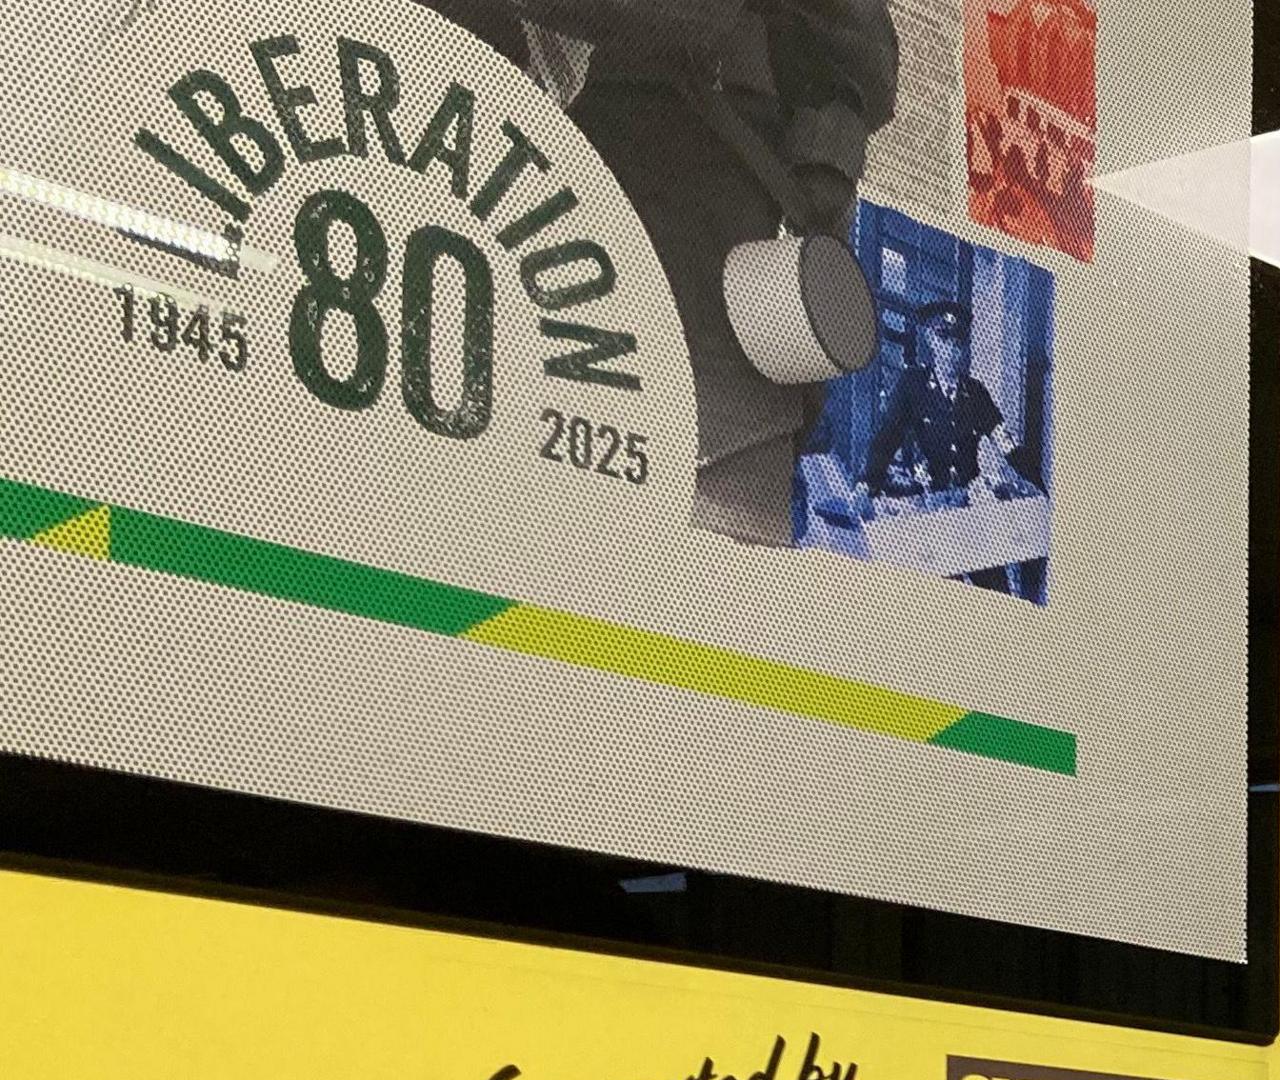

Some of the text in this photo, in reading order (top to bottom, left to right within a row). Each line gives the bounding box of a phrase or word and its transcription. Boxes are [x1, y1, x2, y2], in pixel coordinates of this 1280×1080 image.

[112, 283, 249, 373] 1945
[288, 188, 495, 441] 80
[539, 408, 650, 486] 2025
